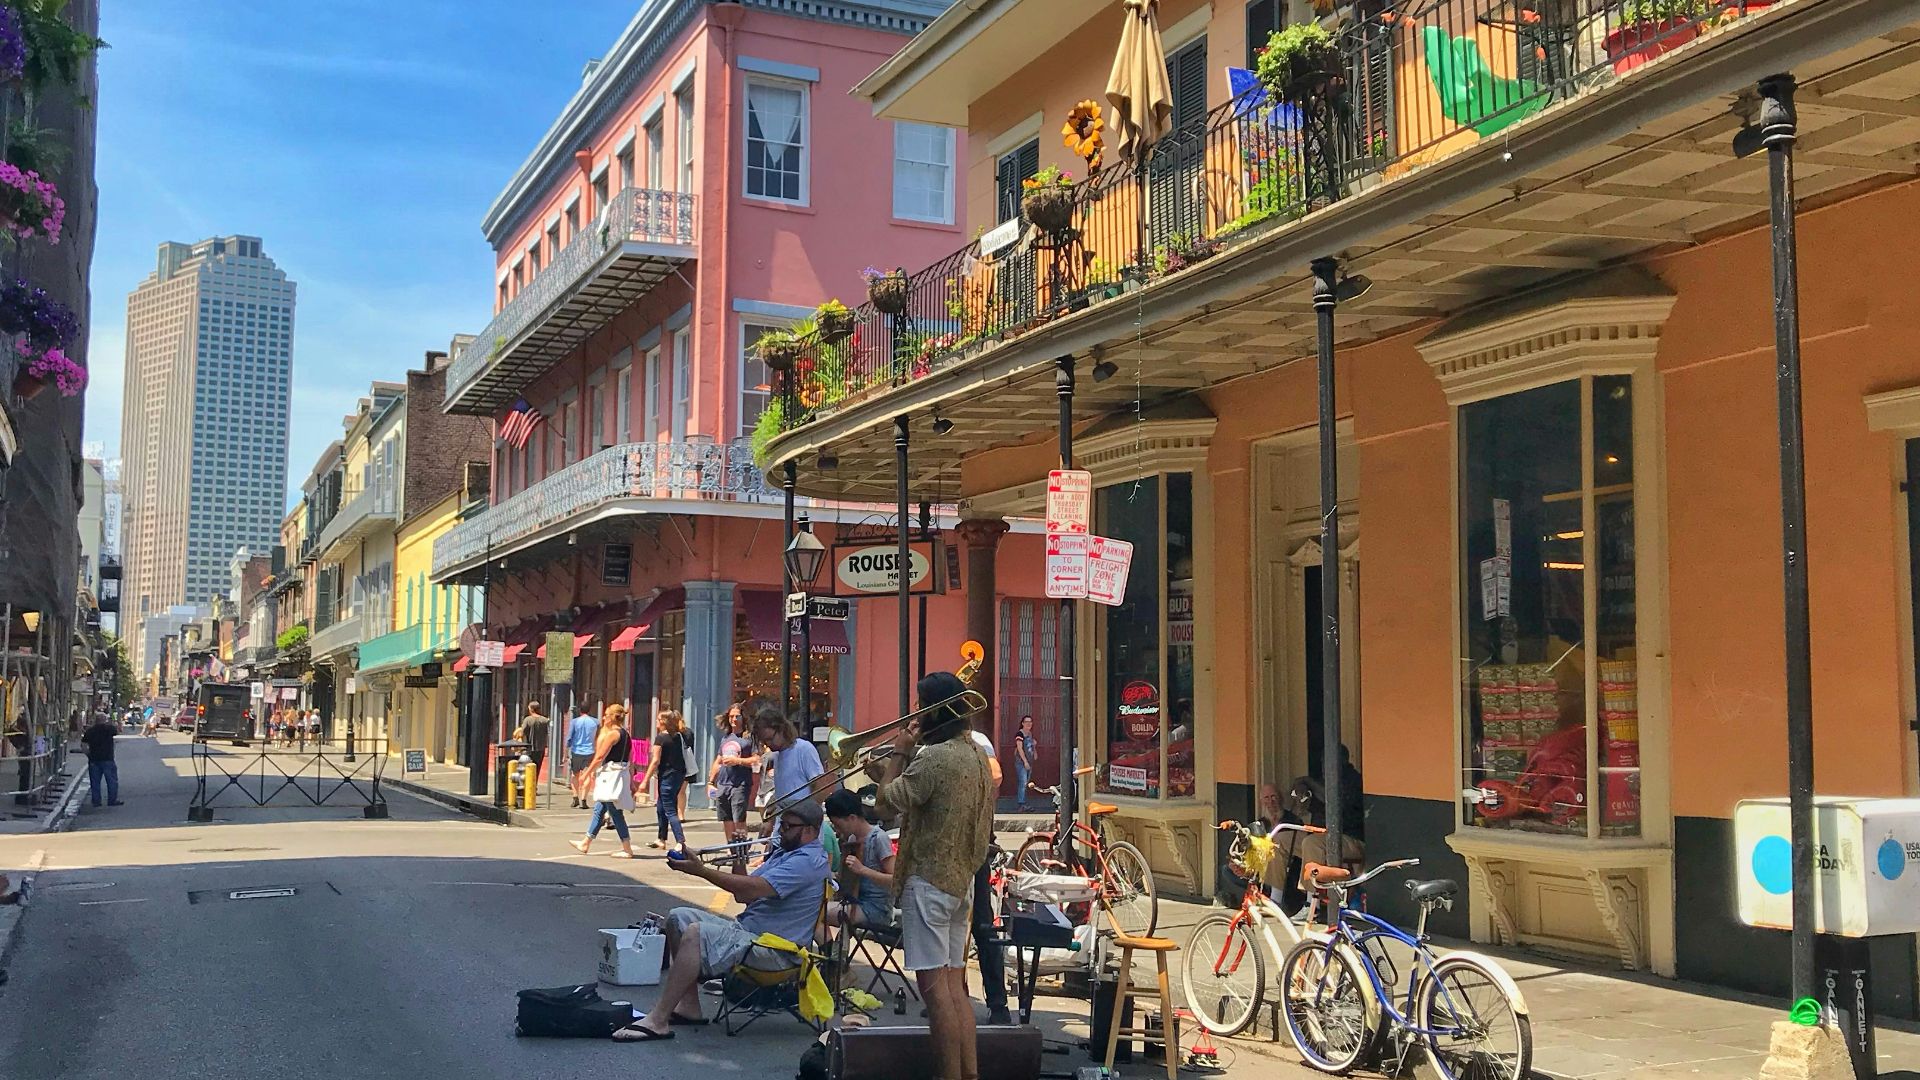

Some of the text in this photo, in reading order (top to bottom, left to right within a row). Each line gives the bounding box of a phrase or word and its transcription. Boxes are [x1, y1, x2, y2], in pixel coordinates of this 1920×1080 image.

[1050, 476, 1088, 487] NO STOPPING
[1054, 500, 1083, 508] THURSDAY
[1048, 539, 1087, 551] NO STOPPING
[1090, 541, 1130, 559] NO PARKING
[1062, 556, 1073, 564] TO
[1051, 565, 1083, 573] CORNER
[1090, 560, 1124, 573] FREIGHT
[887, 571, 919, 580] MAET
[1094, 569, 1116, 582] ZONE
[1049, 584, 1084, 592] ANYTIME
[816, 604, 848, 616] Peter
[760, 641, 848, 654] FISCR AMBINO
[1118, 704, 1159, 716] Budweiser
[1813, 844, 1829, 857] SA
[1906, 851, 1920, 860] TOD
[1813, 857, 1847, 871] ODAY
[1855, 978, 1867, 1053] GANNETT
